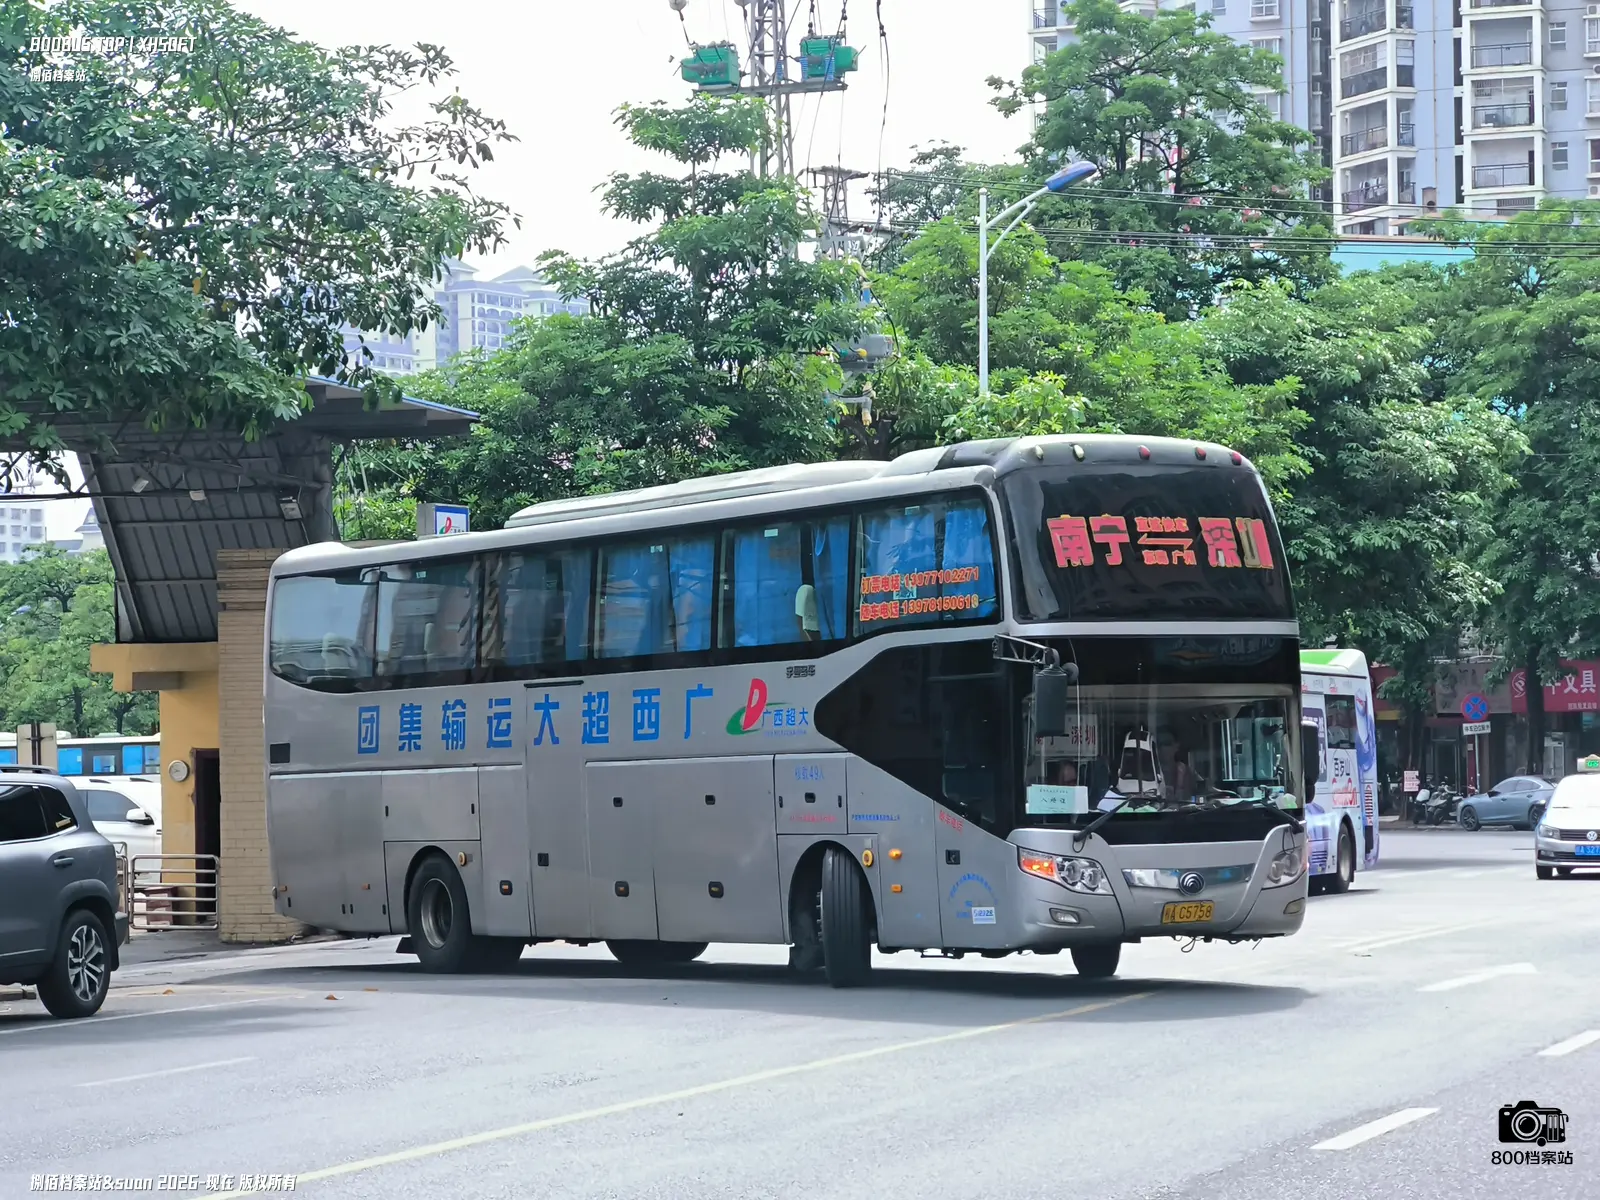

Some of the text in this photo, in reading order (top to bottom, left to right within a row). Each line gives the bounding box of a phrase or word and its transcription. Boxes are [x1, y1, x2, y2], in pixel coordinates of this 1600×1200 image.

[1046, 514, 1130, 568] 南宁
[762, 707, 809, 728] 广西超大
